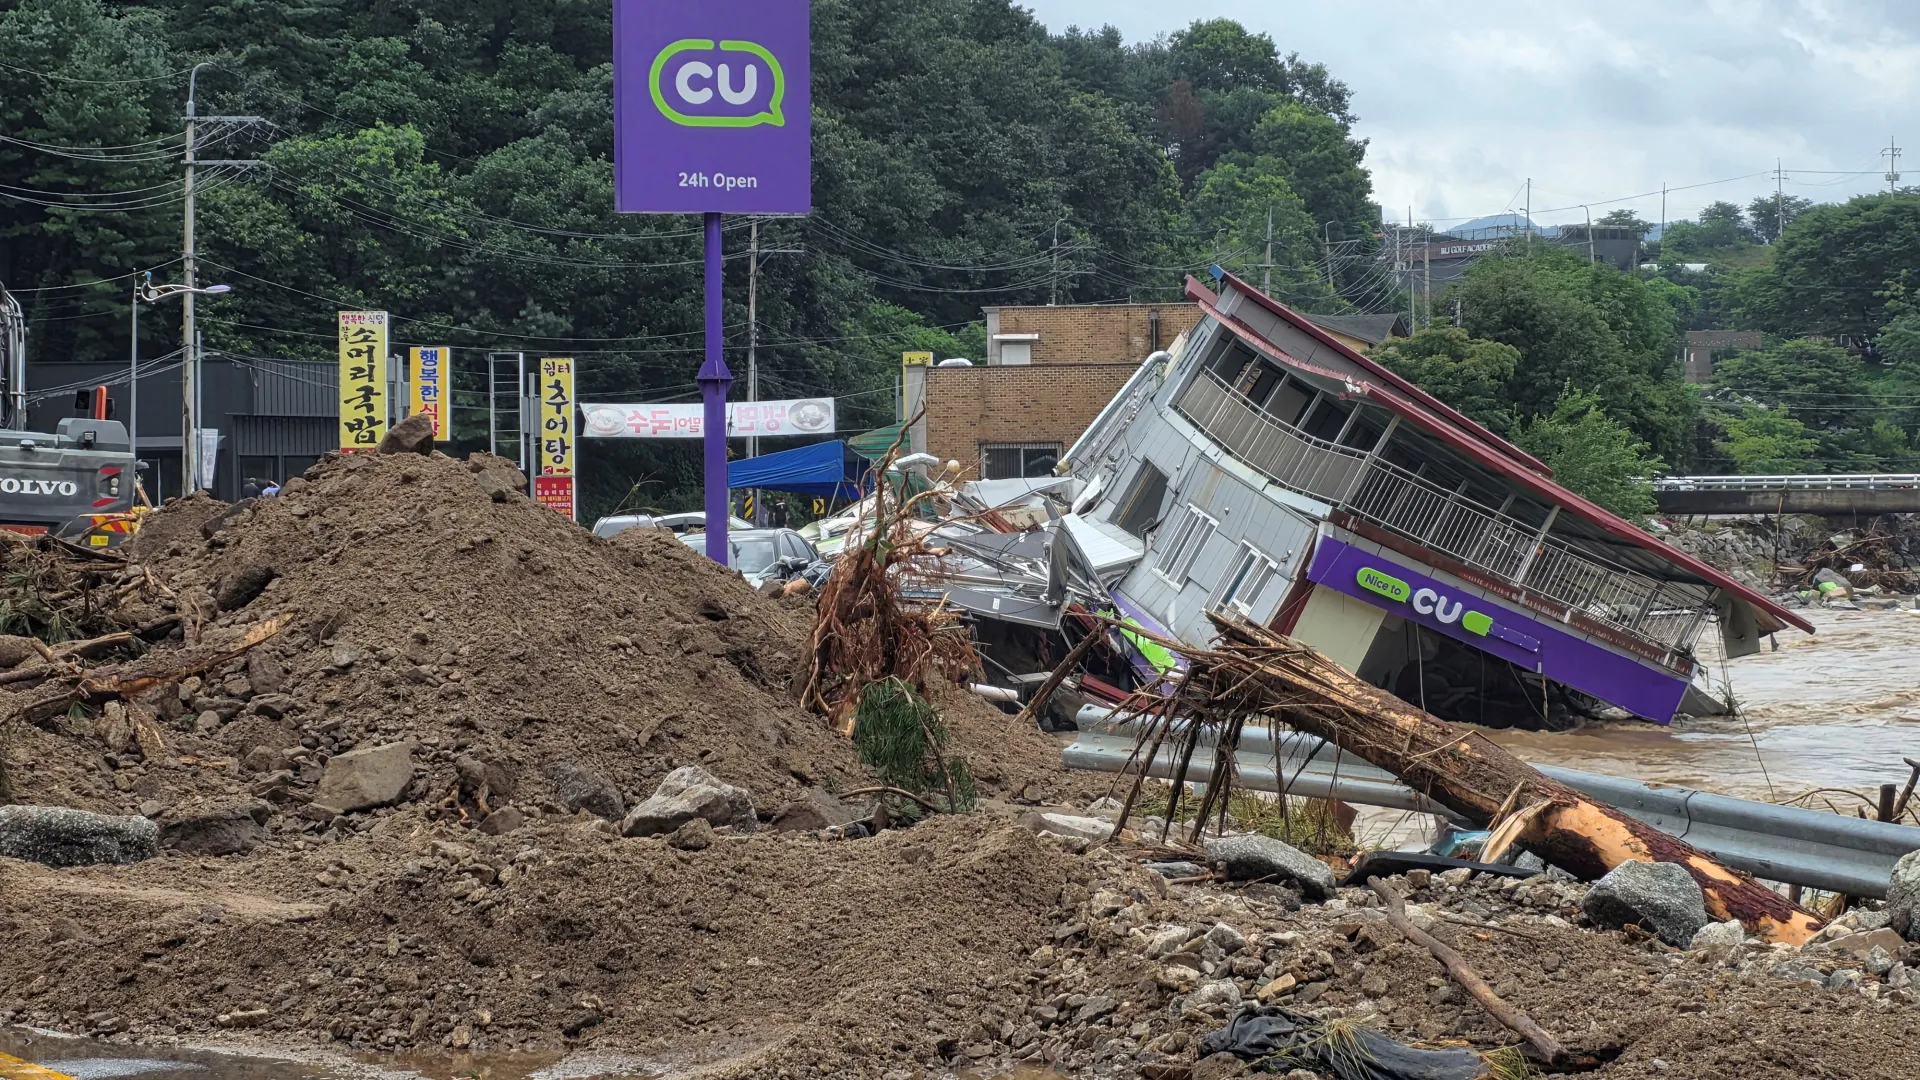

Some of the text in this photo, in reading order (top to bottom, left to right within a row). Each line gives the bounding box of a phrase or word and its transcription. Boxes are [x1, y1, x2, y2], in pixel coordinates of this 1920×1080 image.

[675, 61, 758, 105] CU
[678, 172, 758, 191] 24h Open
[1451, 245, 1467, 254] GOLF
[1467, 243, 1497, 253] ACADE
[341, 314, 384, 325] 행복한 식당
[543, 361, 570, 377] 쉼터
[344, 327, 384, 444] 소머리국밥
[545, 379, 571, 464] 추어탕
[0, 478, 77, 496] OLVO
[1364, 573, 1463, 624] Nice to CU
